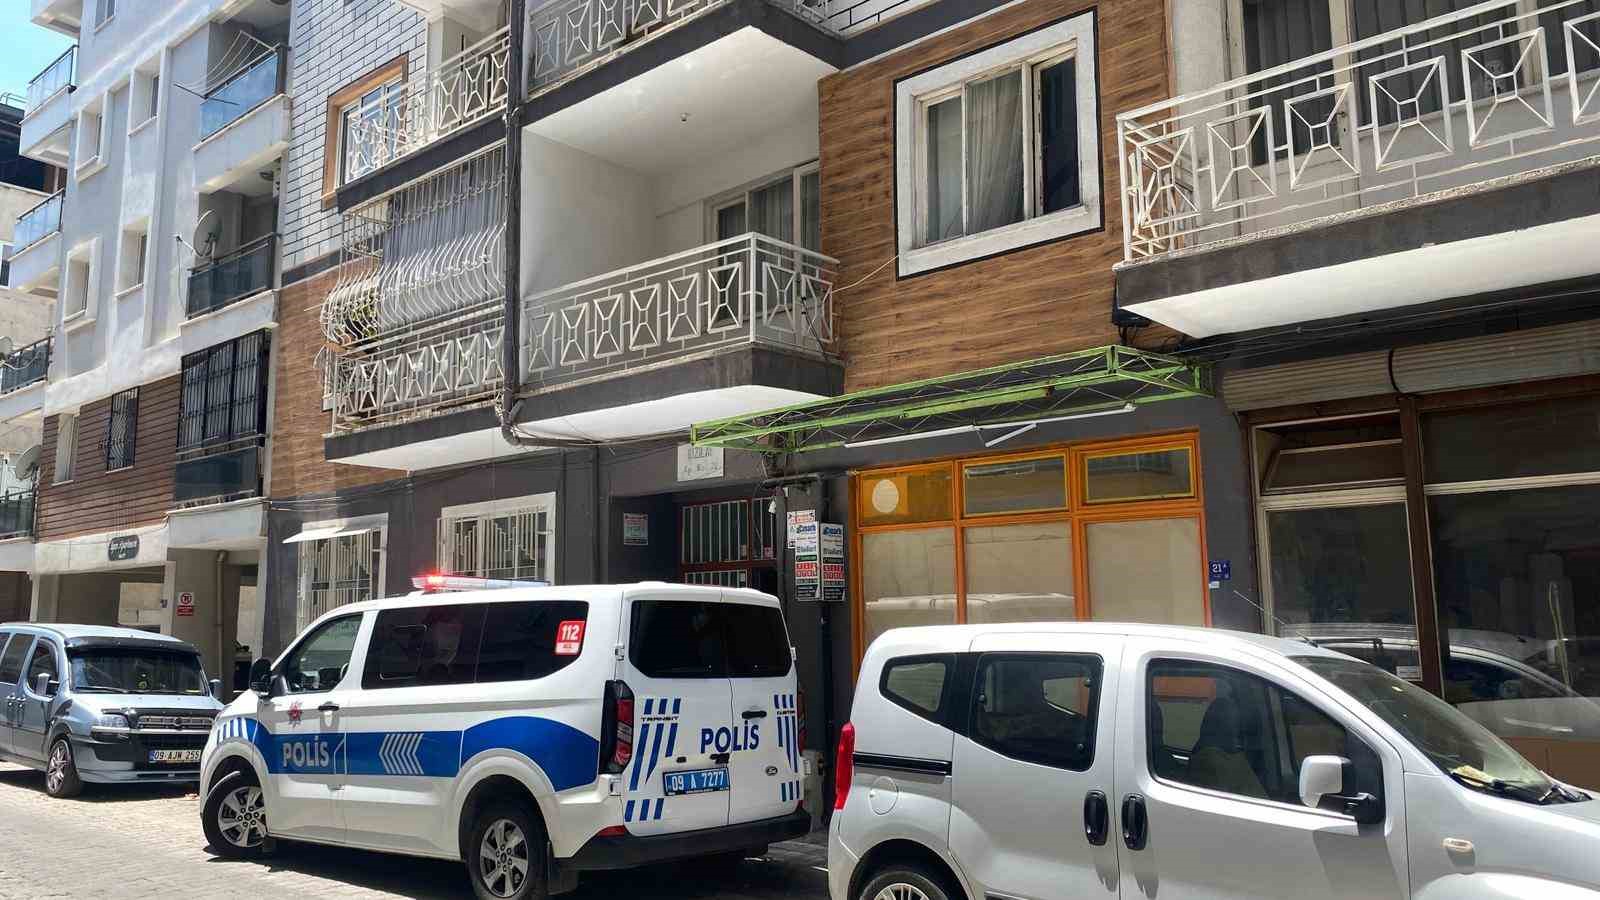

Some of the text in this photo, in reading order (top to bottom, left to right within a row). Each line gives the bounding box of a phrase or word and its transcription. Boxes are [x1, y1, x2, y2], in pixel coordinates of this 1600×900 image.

[561, 624, 580, 641] 112
[700, 720, 760, 754] POLİS
[283, 735, 330, 768] POLİS
[671, 771, 724, 791] 09 A 7277
